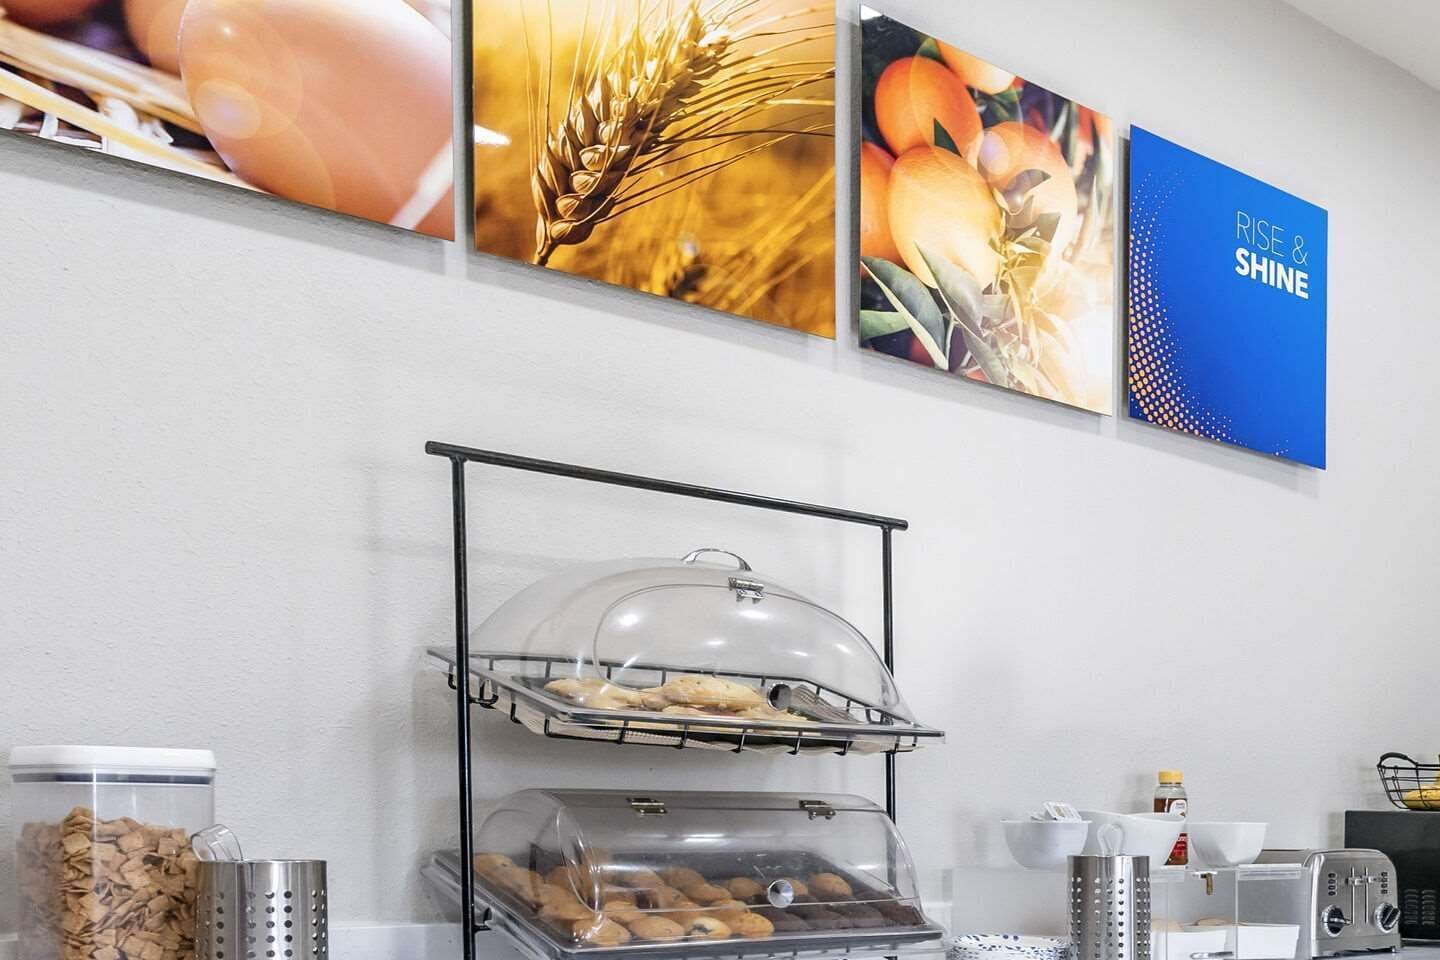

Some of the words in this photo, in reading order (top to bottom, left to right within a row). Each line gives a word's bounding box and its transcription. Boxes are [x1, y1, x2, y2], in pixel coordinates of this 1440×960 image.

[1236, 210, 1285, 258] RISE
[1292, 235, 1308, 266] &
[1235, 247, 1309, 300] SHINE
